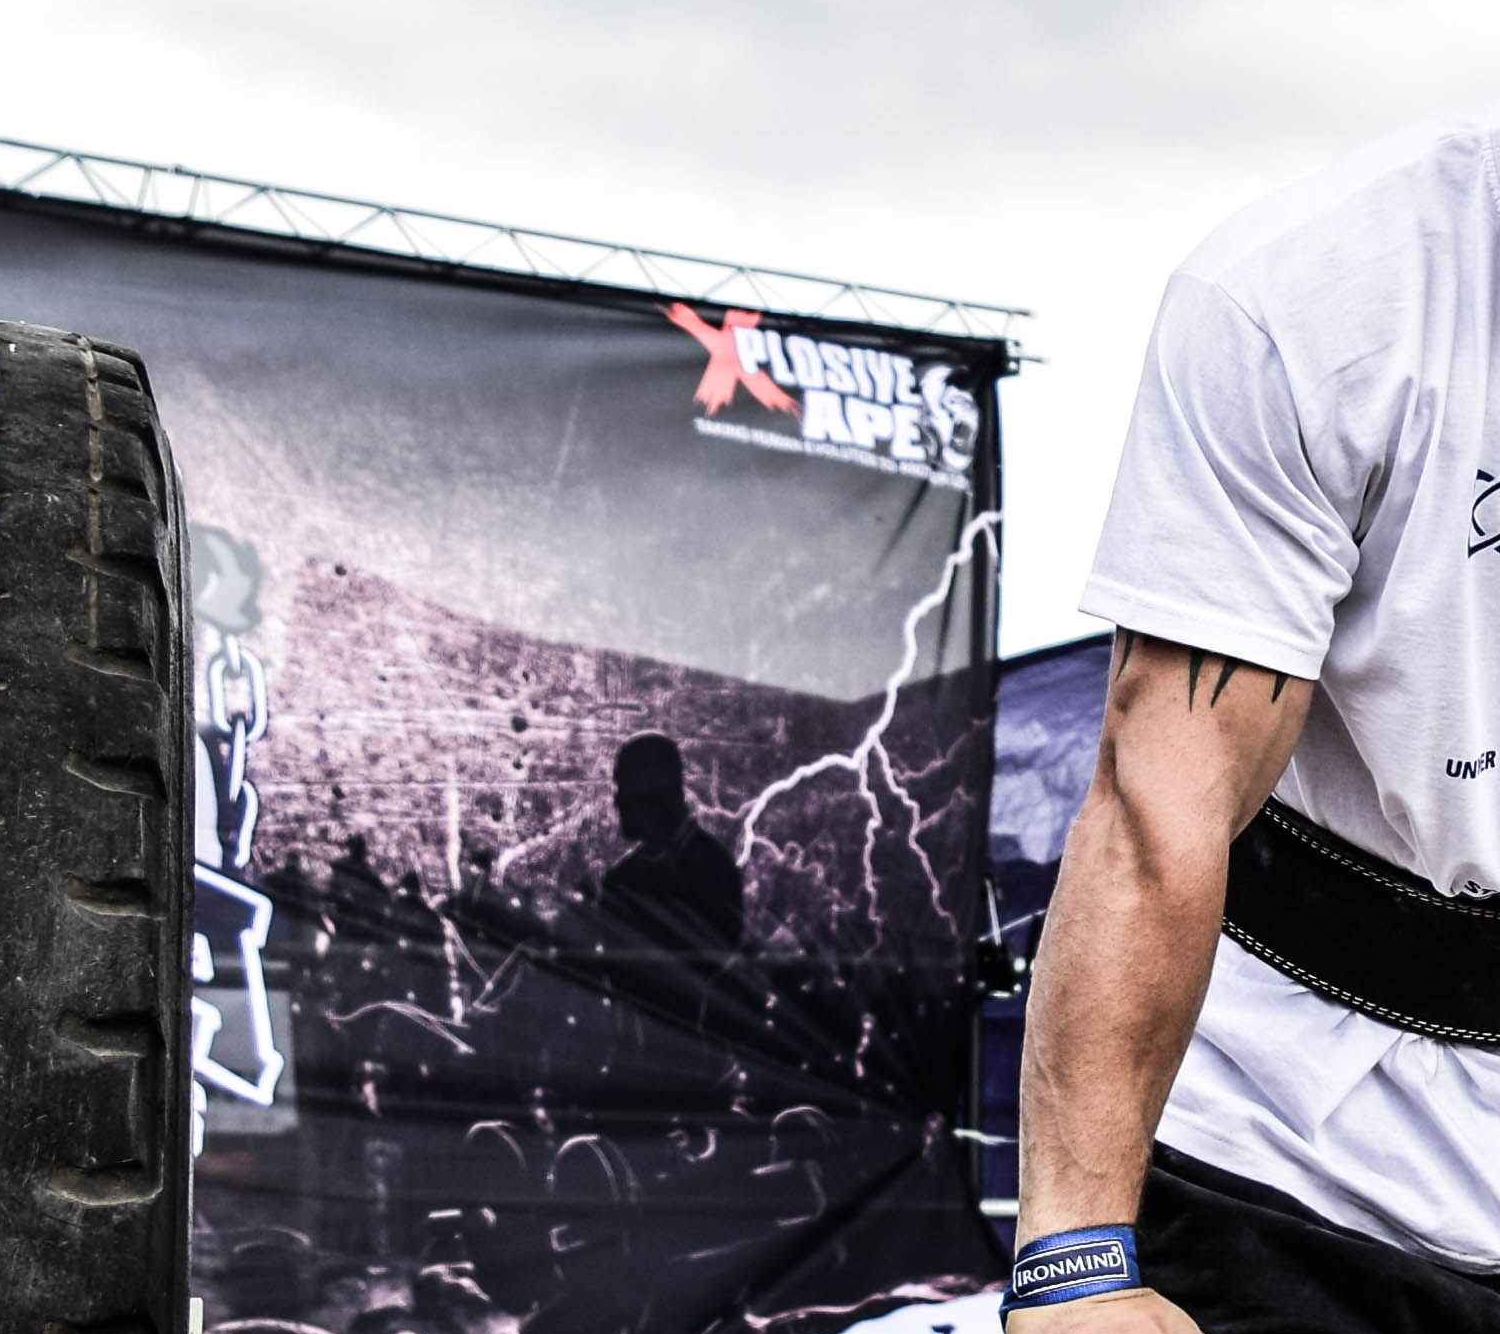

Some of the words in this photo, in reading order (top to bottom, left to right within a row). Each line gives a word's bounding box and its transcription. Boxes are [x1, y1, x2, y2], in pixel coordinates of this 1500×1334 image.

[802, 389, 928, 463] APE
[1445, 750, 1496, 780] UNER
[1016, 1252, 1122, 1288] IRONMIND
